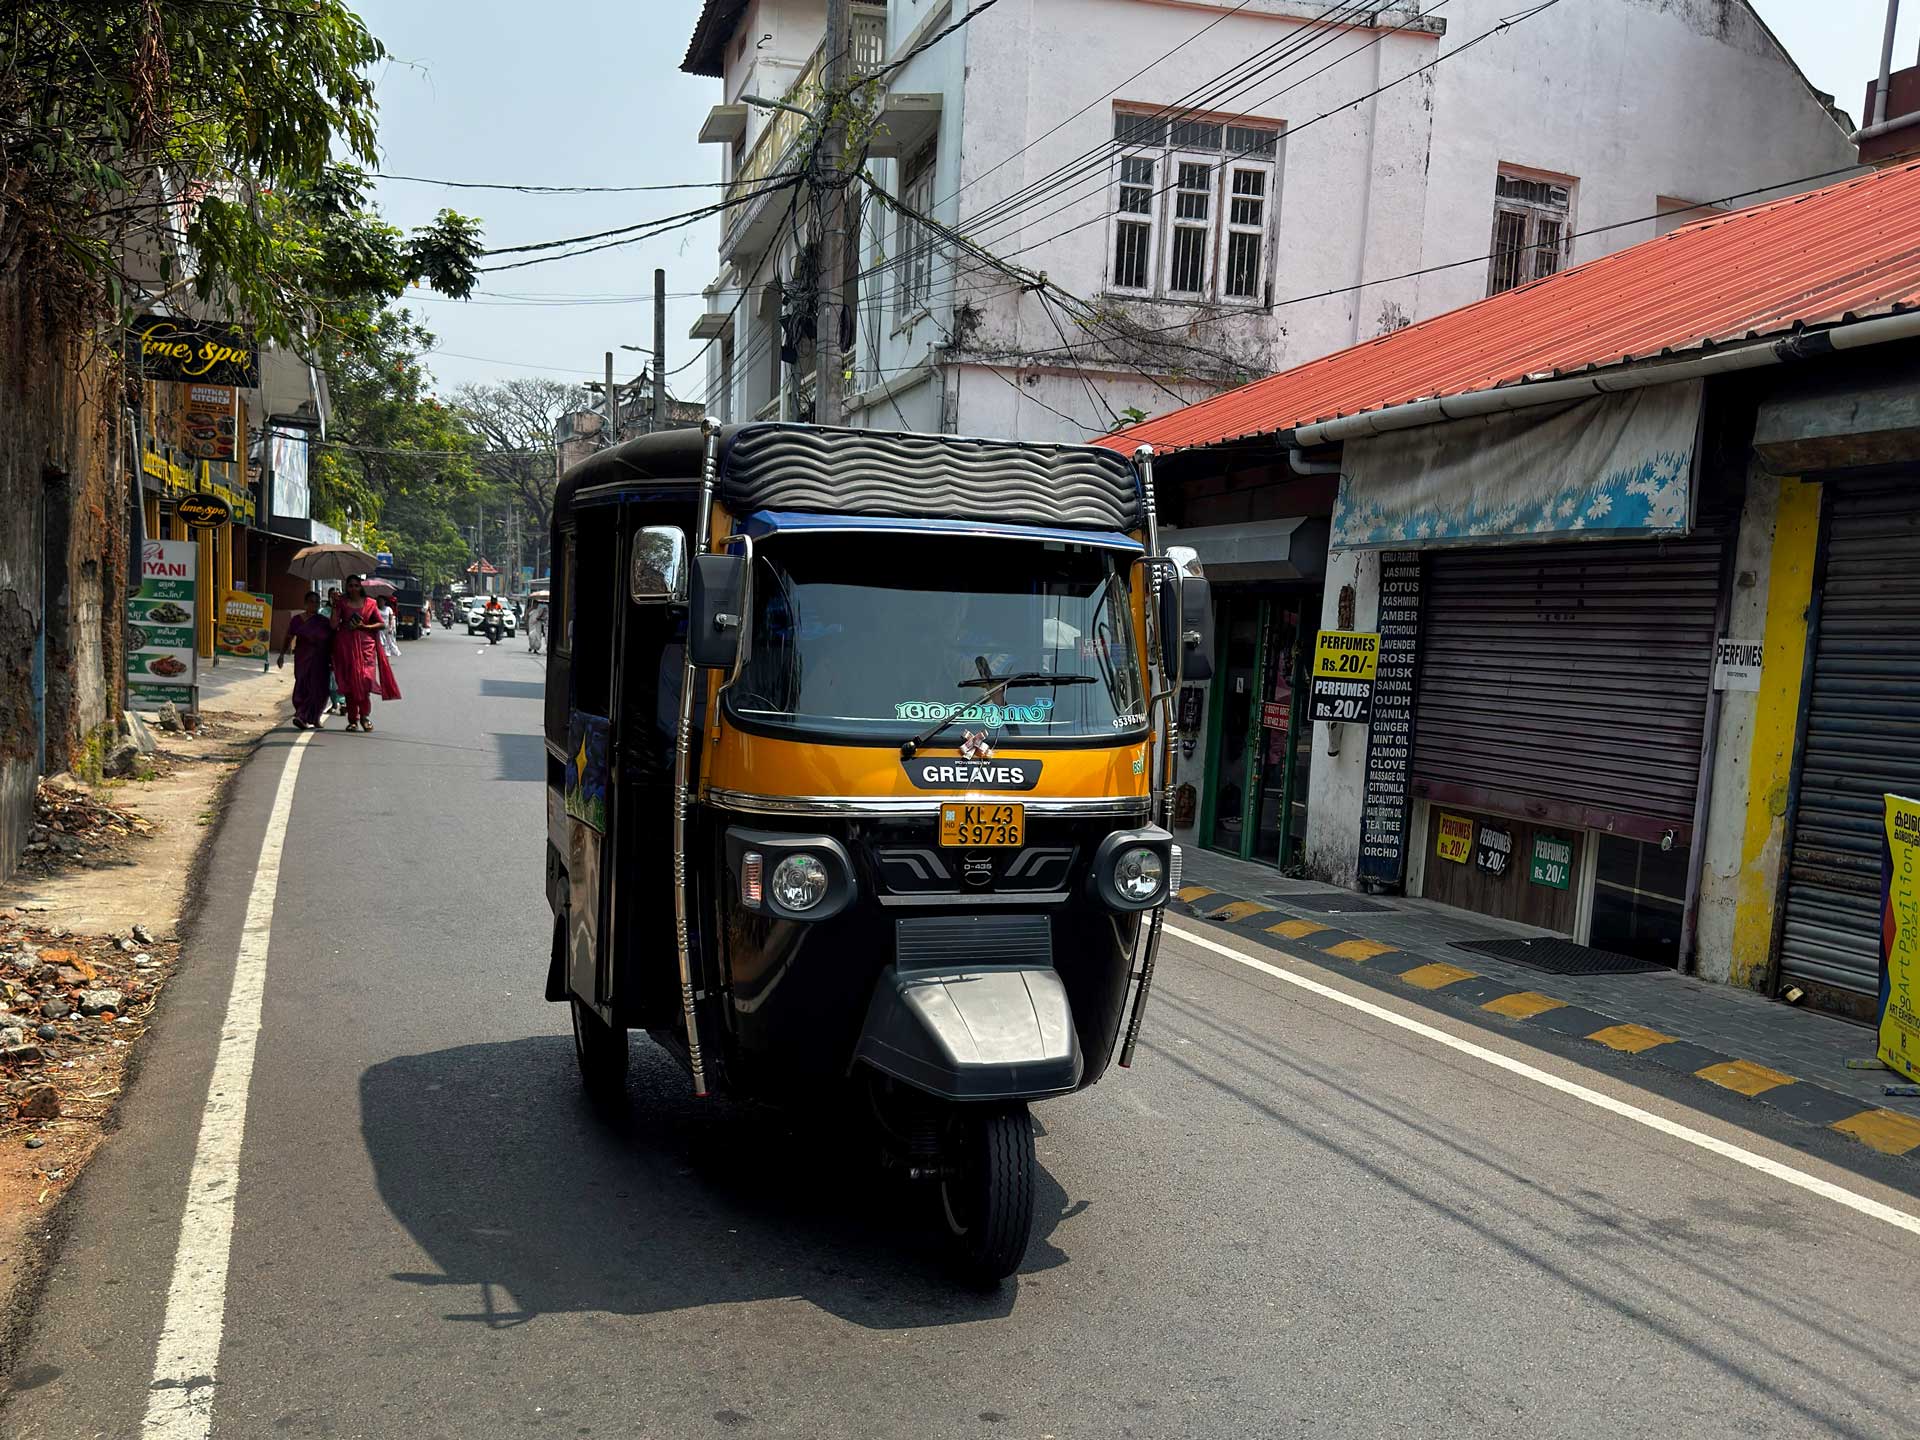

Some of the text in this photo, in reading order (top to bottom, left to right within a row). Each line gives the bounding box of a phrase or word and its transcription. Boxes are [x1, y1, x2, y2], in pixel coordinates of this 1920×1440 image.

[1384, 567, 1420, 577] JASMINE
[1383, 582, 1419, 592] LOTUS
[1382, 596, 1419, 606] KASHMIRI
[1382, 611, 1418, 621] AMBER
[1381, 625, 1417, 635] PATCHOULI
[1320, 635, 1375, 651] PERFUMES
[1380, 640, 1416, 650] LAVENDER
[1380, 653, 1415, 663] ROSE
[1715, 644, 1763, 667] PERFUMES
[1377, 668, 1413, 678] MUSK
[1315, 680, 1370, 697] PERFUMES
[1377, 681, 1413, 691] SANDAL
[1375, 695, 1411, 705] OUDH
[1375, 709, 1410, 719] VANILA
[1373, 722, 1409, 732] GINGER
[1372, 735, 1409, 745] MINT OIL
[1371, 747, 1408, 757] ALMOND
[1370, 759, 1406, 770] CLOVE
[923, 766, 1025, 783] GREAVES
[1369, 771, 1405, 782] MASSAGE OIL
[1369, 782, 1404, 793] CITRONILA
[1368, 794, 1404, 805] EUCALYPTUS
[1364, 820, 1401, 831] TEA TREE
[1441, 818, 1471, 840] PERFUMES
[1364, 833, 1400, 845] CHAMPA
[1479, 827, 1511, 853] PERFUMES
[1364, 846, 1399, 858] ORCHID
[1535, 840, 1570, 864] PERFUMES
